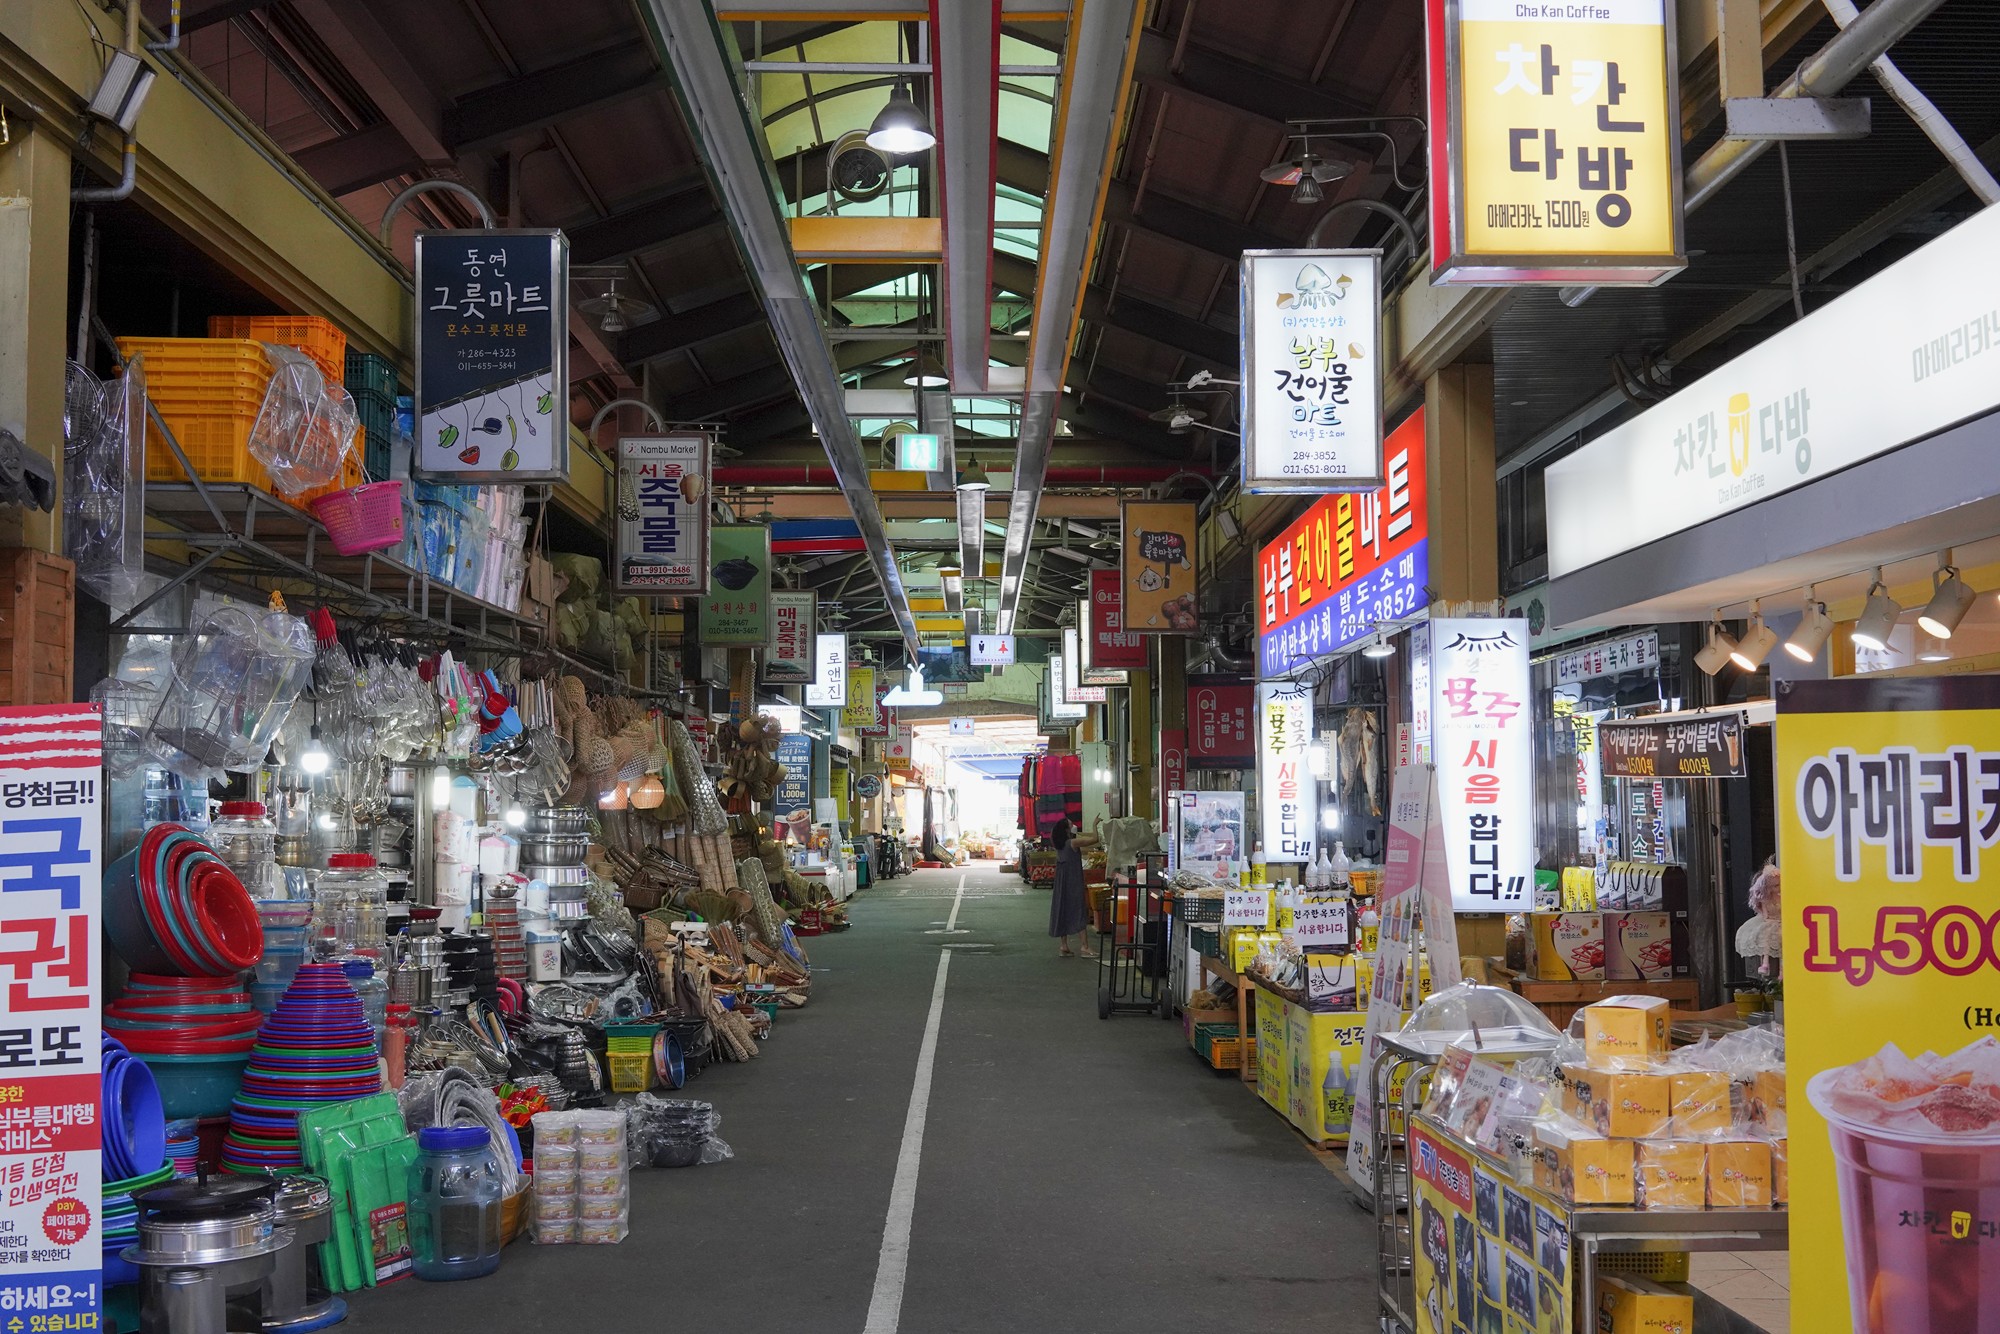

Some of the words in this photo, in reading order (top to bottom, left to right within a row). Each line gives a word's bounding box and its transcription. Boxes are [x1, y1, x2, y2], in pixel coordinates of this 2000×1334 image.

[1516, 4, 1538, 17] Cha
[1541, 4, 1563, 18] Kan
[1567, 5, 1610, 19] Coffee
[1494, 43, 1645, 133] 차칸
[1509, 128, 1633, 228] 다방
[1487, 204, 1542, 228] 아메리카노
[1545, 200, 1590, 228] 1500원
[462, 249, 508, 278] 동연
[430, 281, 549, 319] 그릇마트
[458, 362, 516, 371] 011-655-3841
[467, 348, 517, 358] 286-4323
[1289, 334, 1338, 371] 남부
[1274, 363, 1352, 404] 건어물
[1291, 399, 1342, 425] 마트
[1289, 429, 1316, 441] 건어물
[1673, 411, 1726, 479] 차칸
[1759, 387, 1812, 475] 다방
[640, 445, 668, 454] Nambu
[671, 445, 697, 454] Market
[639, 463, 683, 478] 서울
[1718, 487, 1730, 504] Cha
[1742, 472, 1765, 494] Coffee
[827, 653, 842, 699] 로앤진
[1609, 727, 1659, 754] 아메리카노
[1665, 721, 1722, 753] 흑당버블티
[1627, 757, 1655, 776] 1500원
[1679, 757, 1711, 775] 4000원
[3, 780, 94, 808] 당첨금!!
[0, 817, 91, 910] 국
[1228, 896, 1243, 905] 전주
[1228, 908, 1265, 918] 시음합니다
[1803, 905, 2000, 986] 1,50
[0, 914, 89, 1013] 권
[0, 1026, 83, 1068] 로또
[0, 1163, 25, 1184] 1등
[32, 1152, 66, 1179] 당첨
[9, 1172, 79, 1207] 인생역전
[46, 1214, 86, 1227] 페이결제
[57, 1201, 76, 1213] pay
[56, 1229, 76, 1241] 가능
[1977, 1221, 2000, 1238] 다
[31, 1248, 71, 1262] 확인한다
[0, 1284, 96, 1312] 하세요~!
[7, 1316, 25, 1333] 수
[30, 1312, 99, 1333] 있습니다
